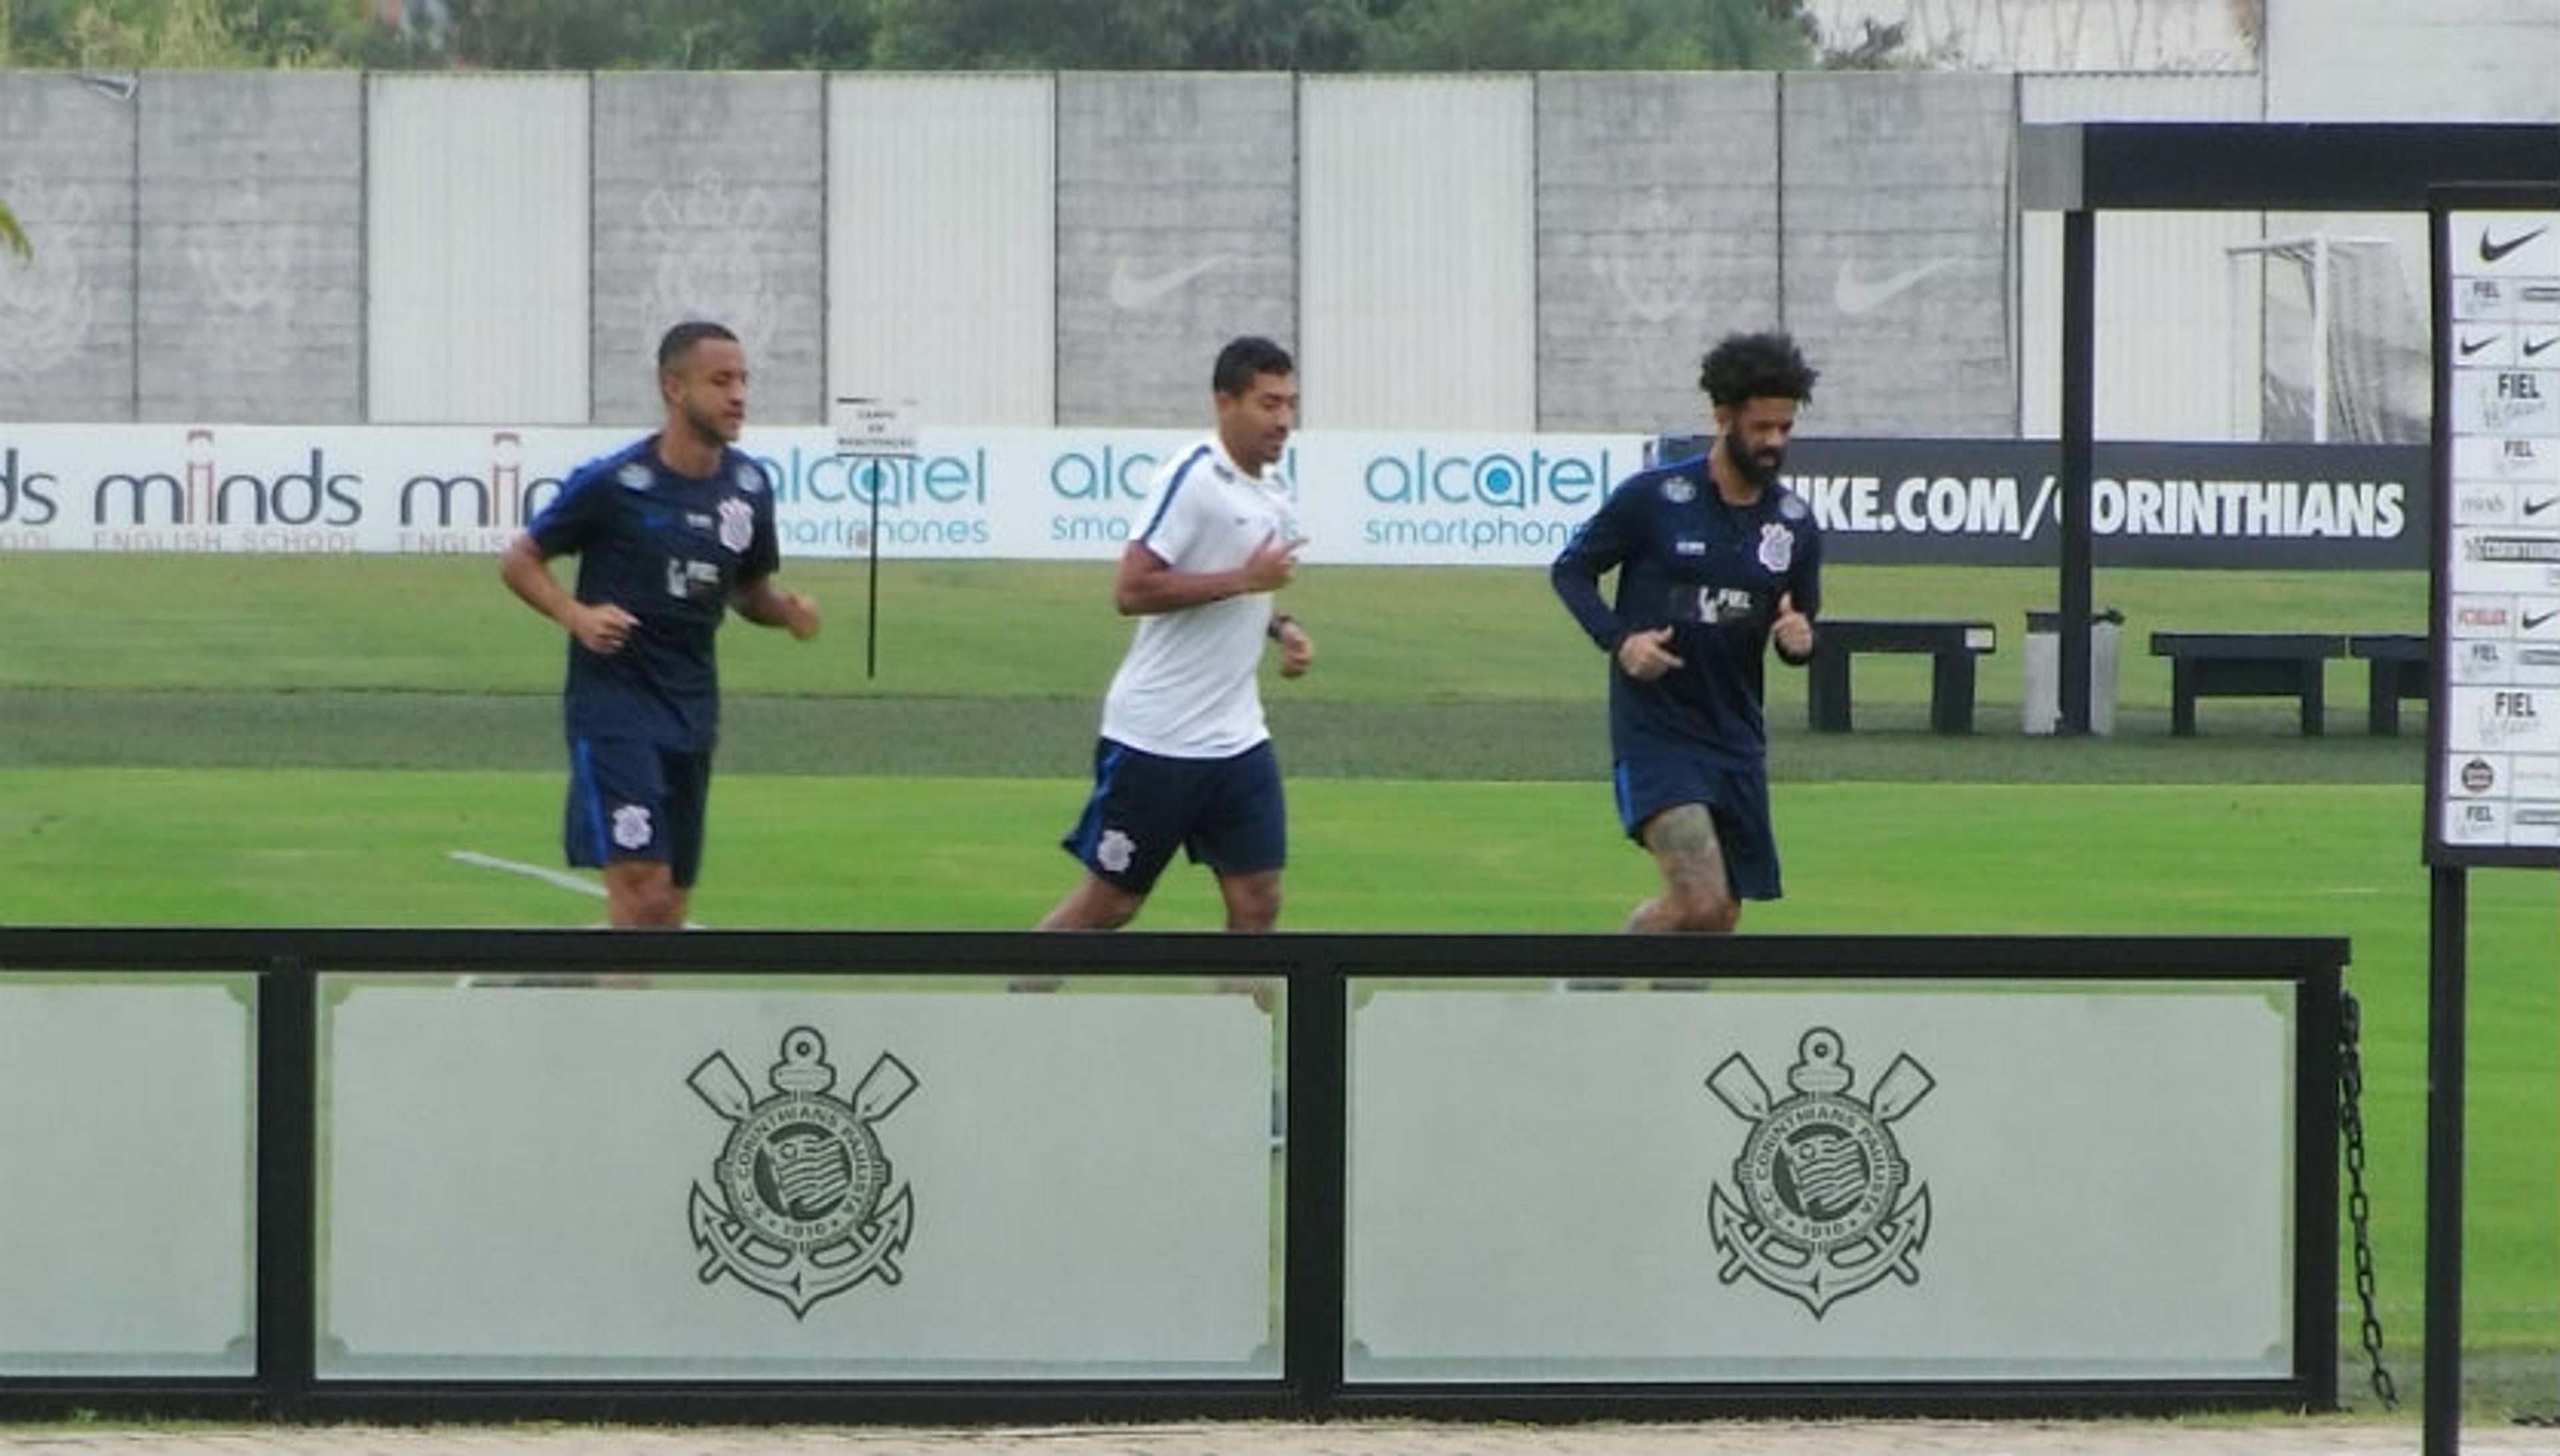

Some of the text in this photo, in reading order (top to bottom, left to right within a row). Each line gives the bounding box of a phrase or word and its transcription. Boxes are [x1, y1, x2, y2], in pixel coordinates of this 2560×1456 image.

[2498, 373, 2540, 399] FIEL
[2503, 441, 2535, 457] FIEL
[95, 430, 361, 525] minds
[1365, 447, 1616, 509] alcatel
[2473, 643, 2500, 663] FIEL
[2494, 691, 2537, 718] FIEL
[2467, 805, 2493, 822] FIEL
[1802, 1221, 1845, 1239] 1910
